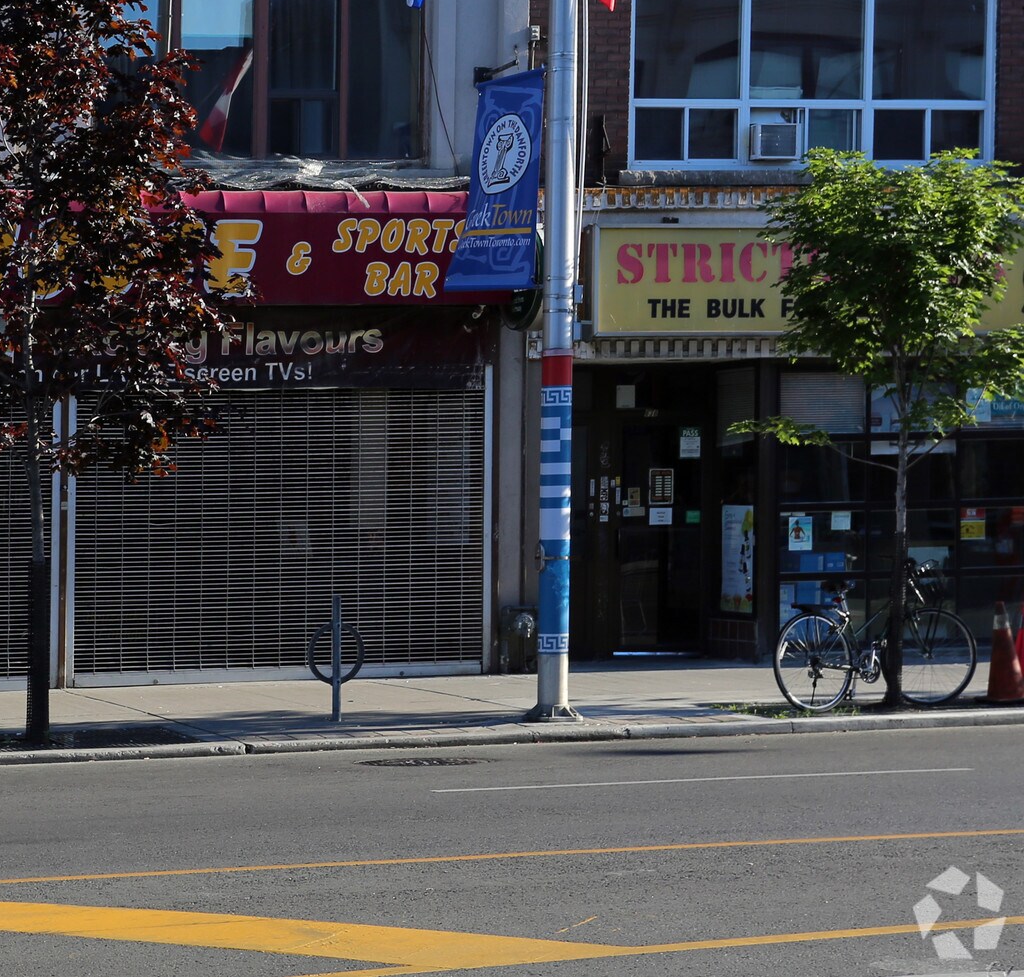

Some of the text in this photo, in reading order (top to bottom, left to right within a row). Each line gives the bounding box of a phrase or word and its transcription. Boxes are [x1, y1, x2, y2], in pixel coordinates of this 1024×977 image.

[496, 121, 506, 133] ON
[509, 126, 527, 177] DANFORTH
[286, 241, 312, 276] &
[364, 261, 439, 298] BAR
[647, 298, 691, 319] THE
[706, 298, 766, 319] BULK
[221, 322, 384, 356] Flavours
[184, 366, 257, 383] screen
[265, 362, 313, 380] TVs!
[682, 429, 699, 437] PASS
